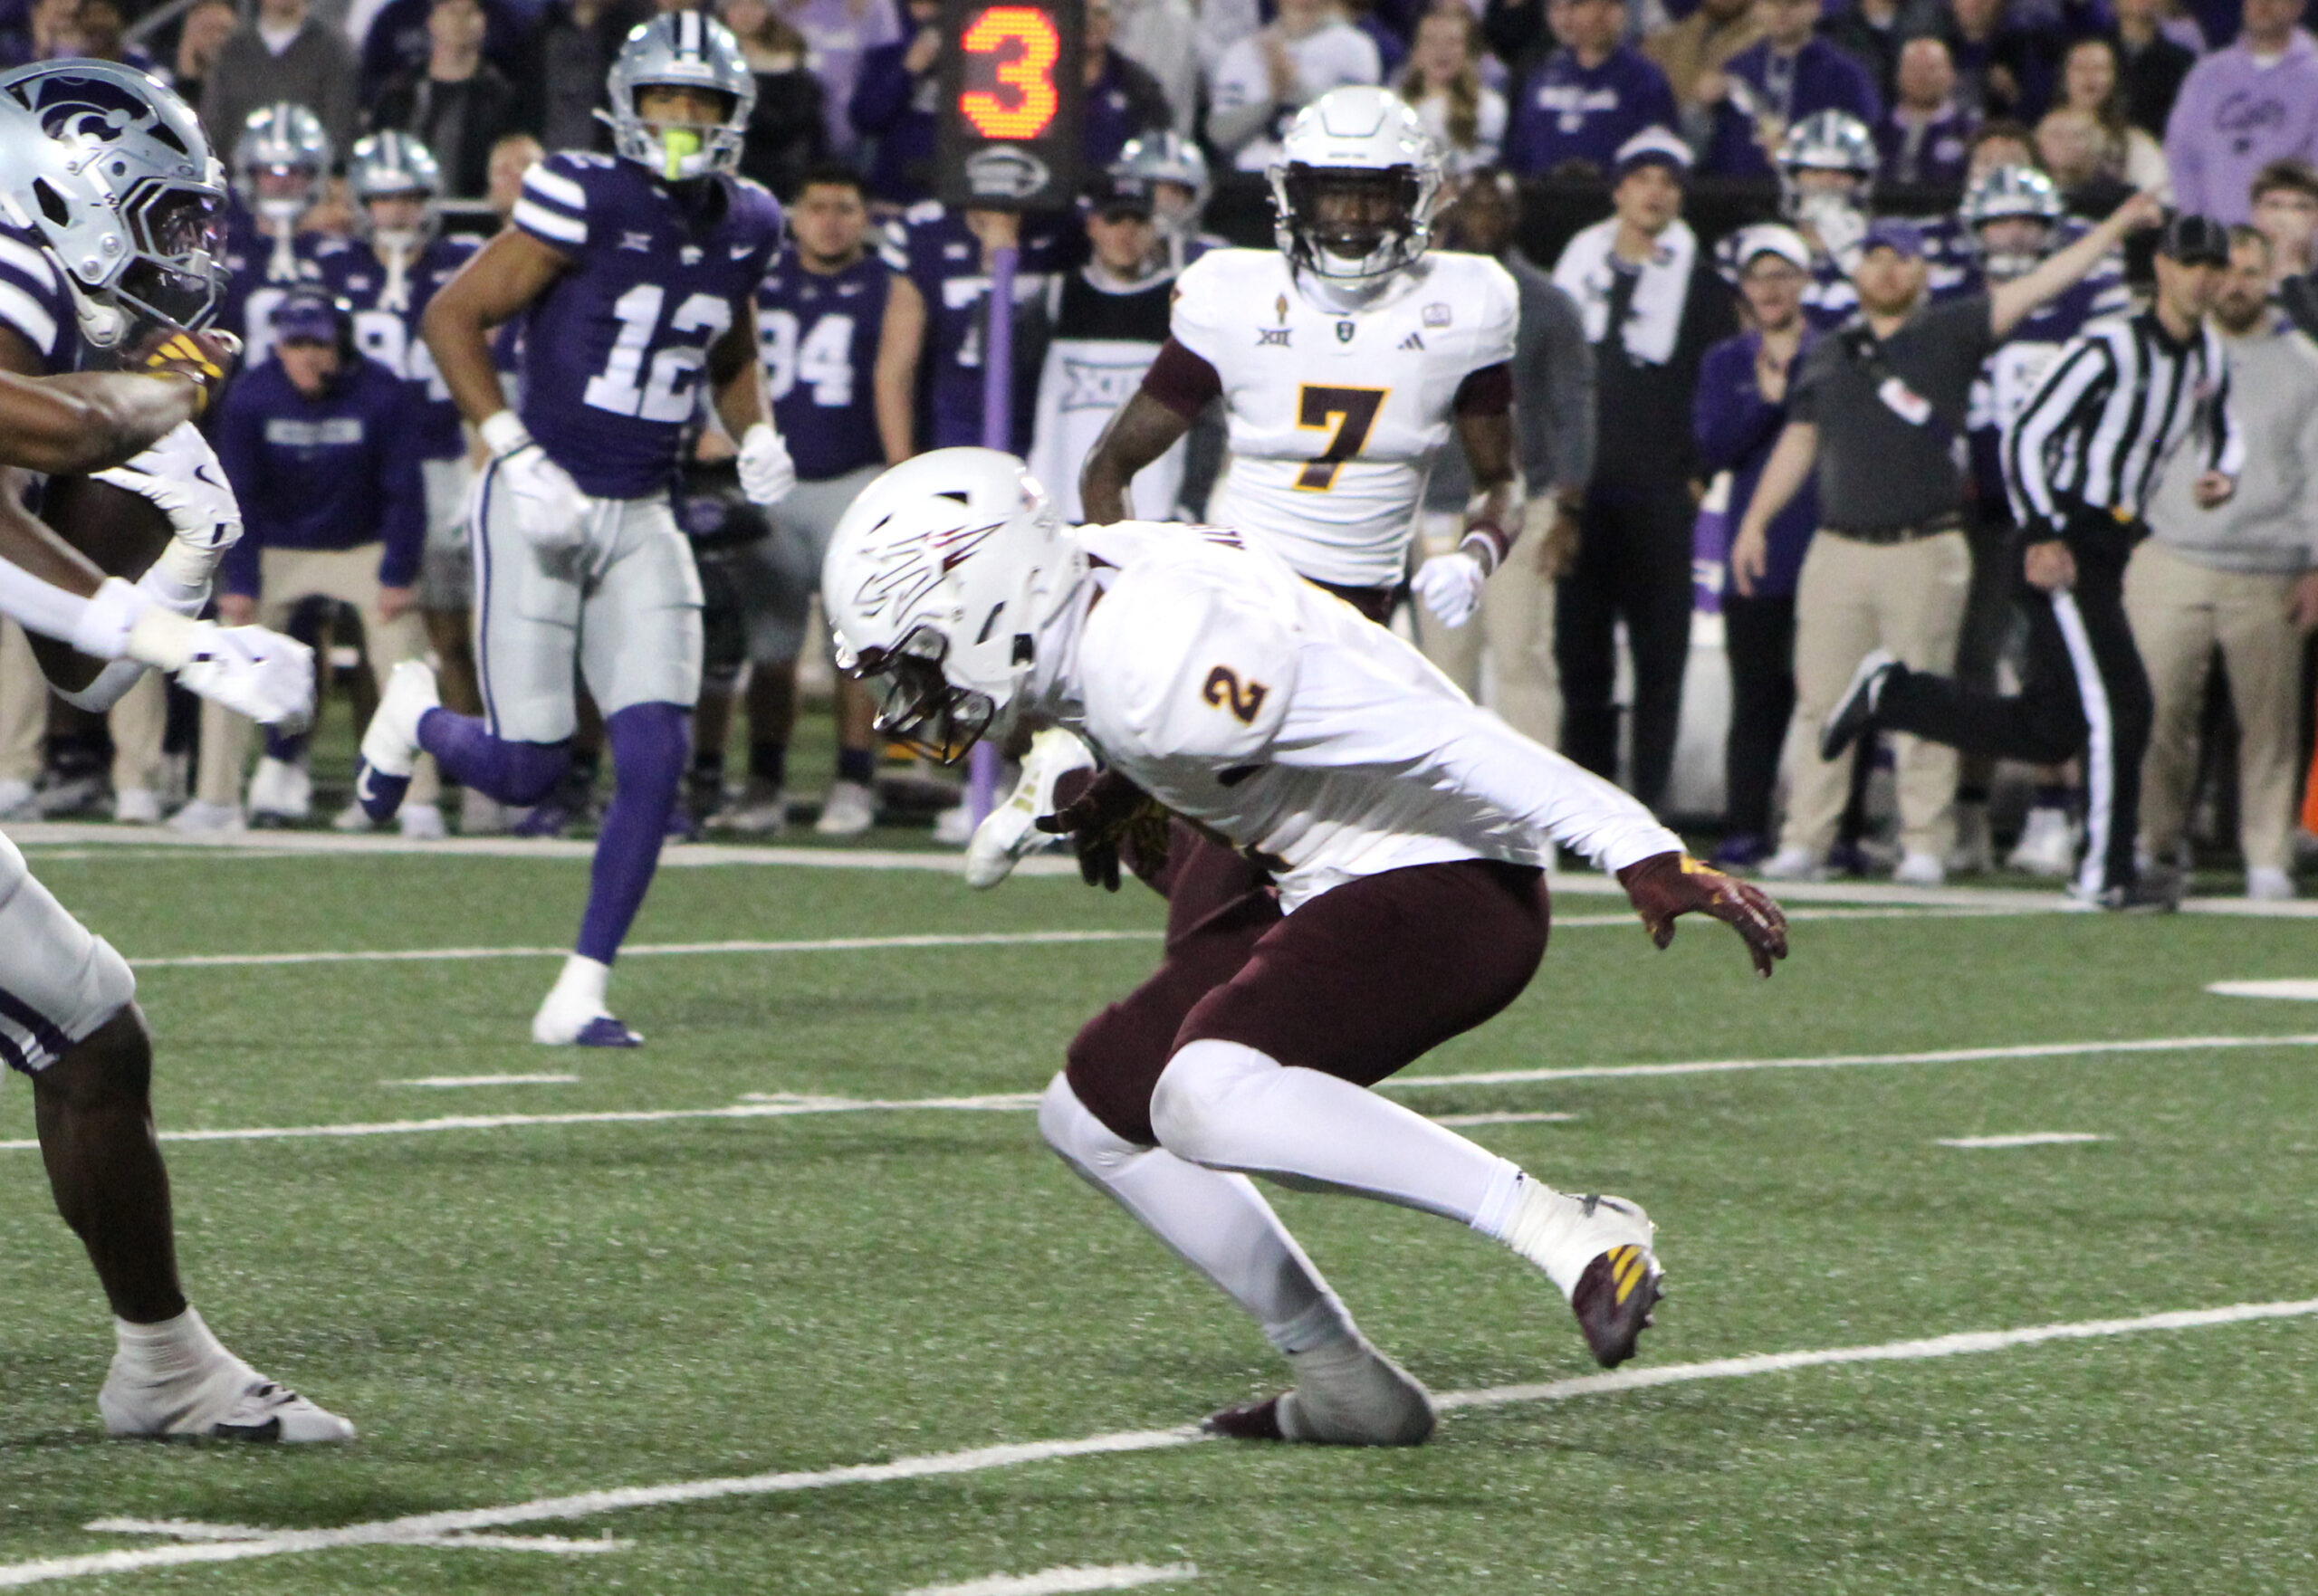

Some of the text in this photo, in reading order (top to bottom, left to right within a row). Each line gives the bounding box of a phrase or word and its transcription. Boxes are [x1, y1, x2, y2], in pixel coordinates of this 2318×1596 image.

[959, 6, 1060, 139] 3
[583, 283, 732, 423] 12
[1292, 383, 1393, 492] 7
[1202, 665, 1269, 727] 2
